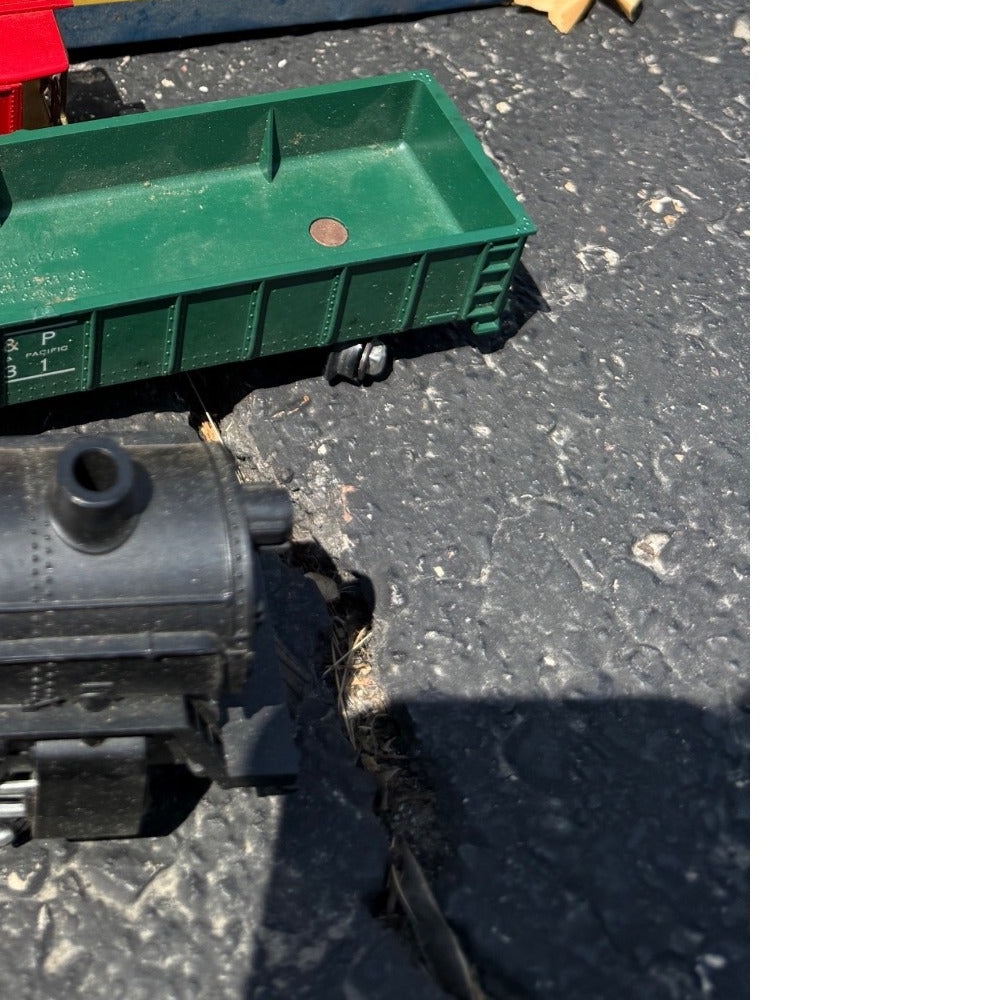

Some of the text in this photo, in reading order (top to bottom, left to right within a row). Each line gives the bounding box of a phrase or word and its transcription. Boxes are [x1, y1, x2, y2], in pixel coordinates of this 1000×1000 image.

[4, 338, 19, 353] &
[41, 330, 56, 346] P
[25, 344, 69, 358] PACIFIC
